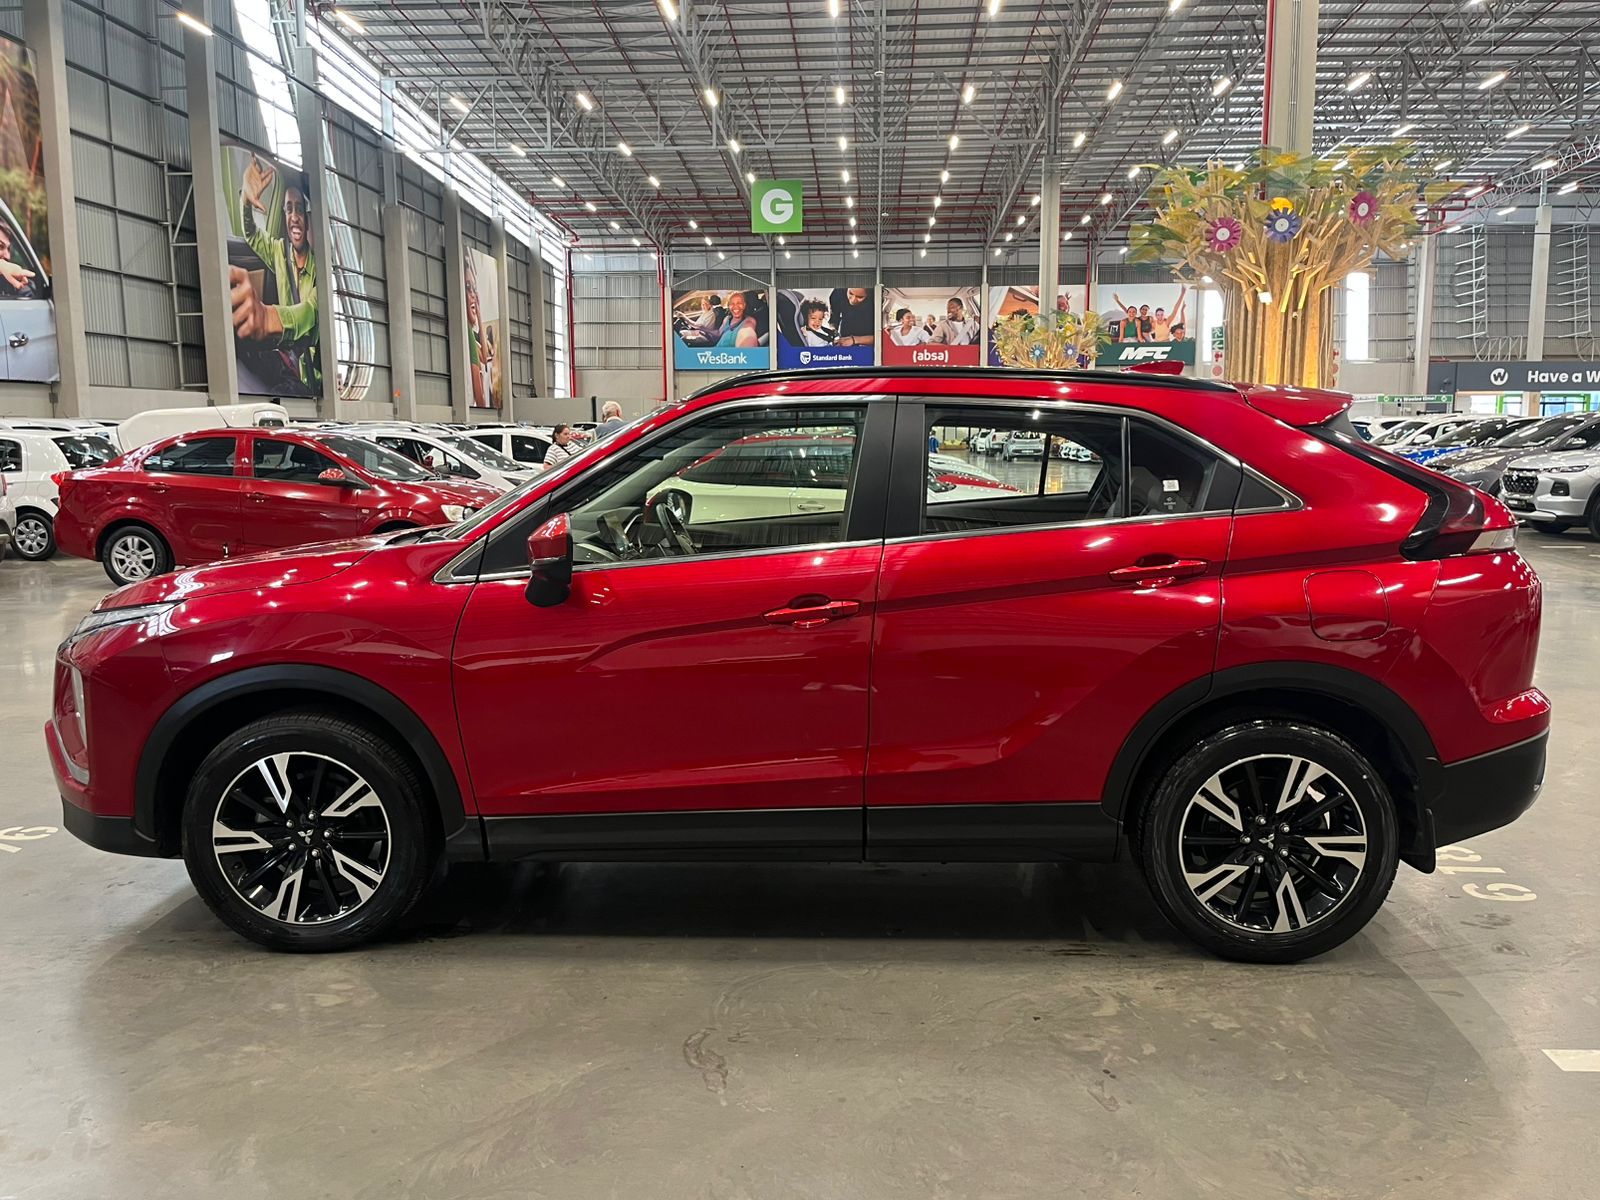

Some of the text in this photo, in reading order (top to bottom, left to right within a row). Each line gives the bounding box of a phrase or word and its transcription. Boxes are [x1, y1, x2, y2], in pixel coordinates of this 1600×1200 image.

[760, 188, 794, 224] G
[696, 351, 748, 364] WesBank
[913, 349, 948, 363] (absa)
[1119, 346, 1172, 360] MFC
[1527, 370, 1569, 383] Have
[1571, 372, 1583, 383] a
